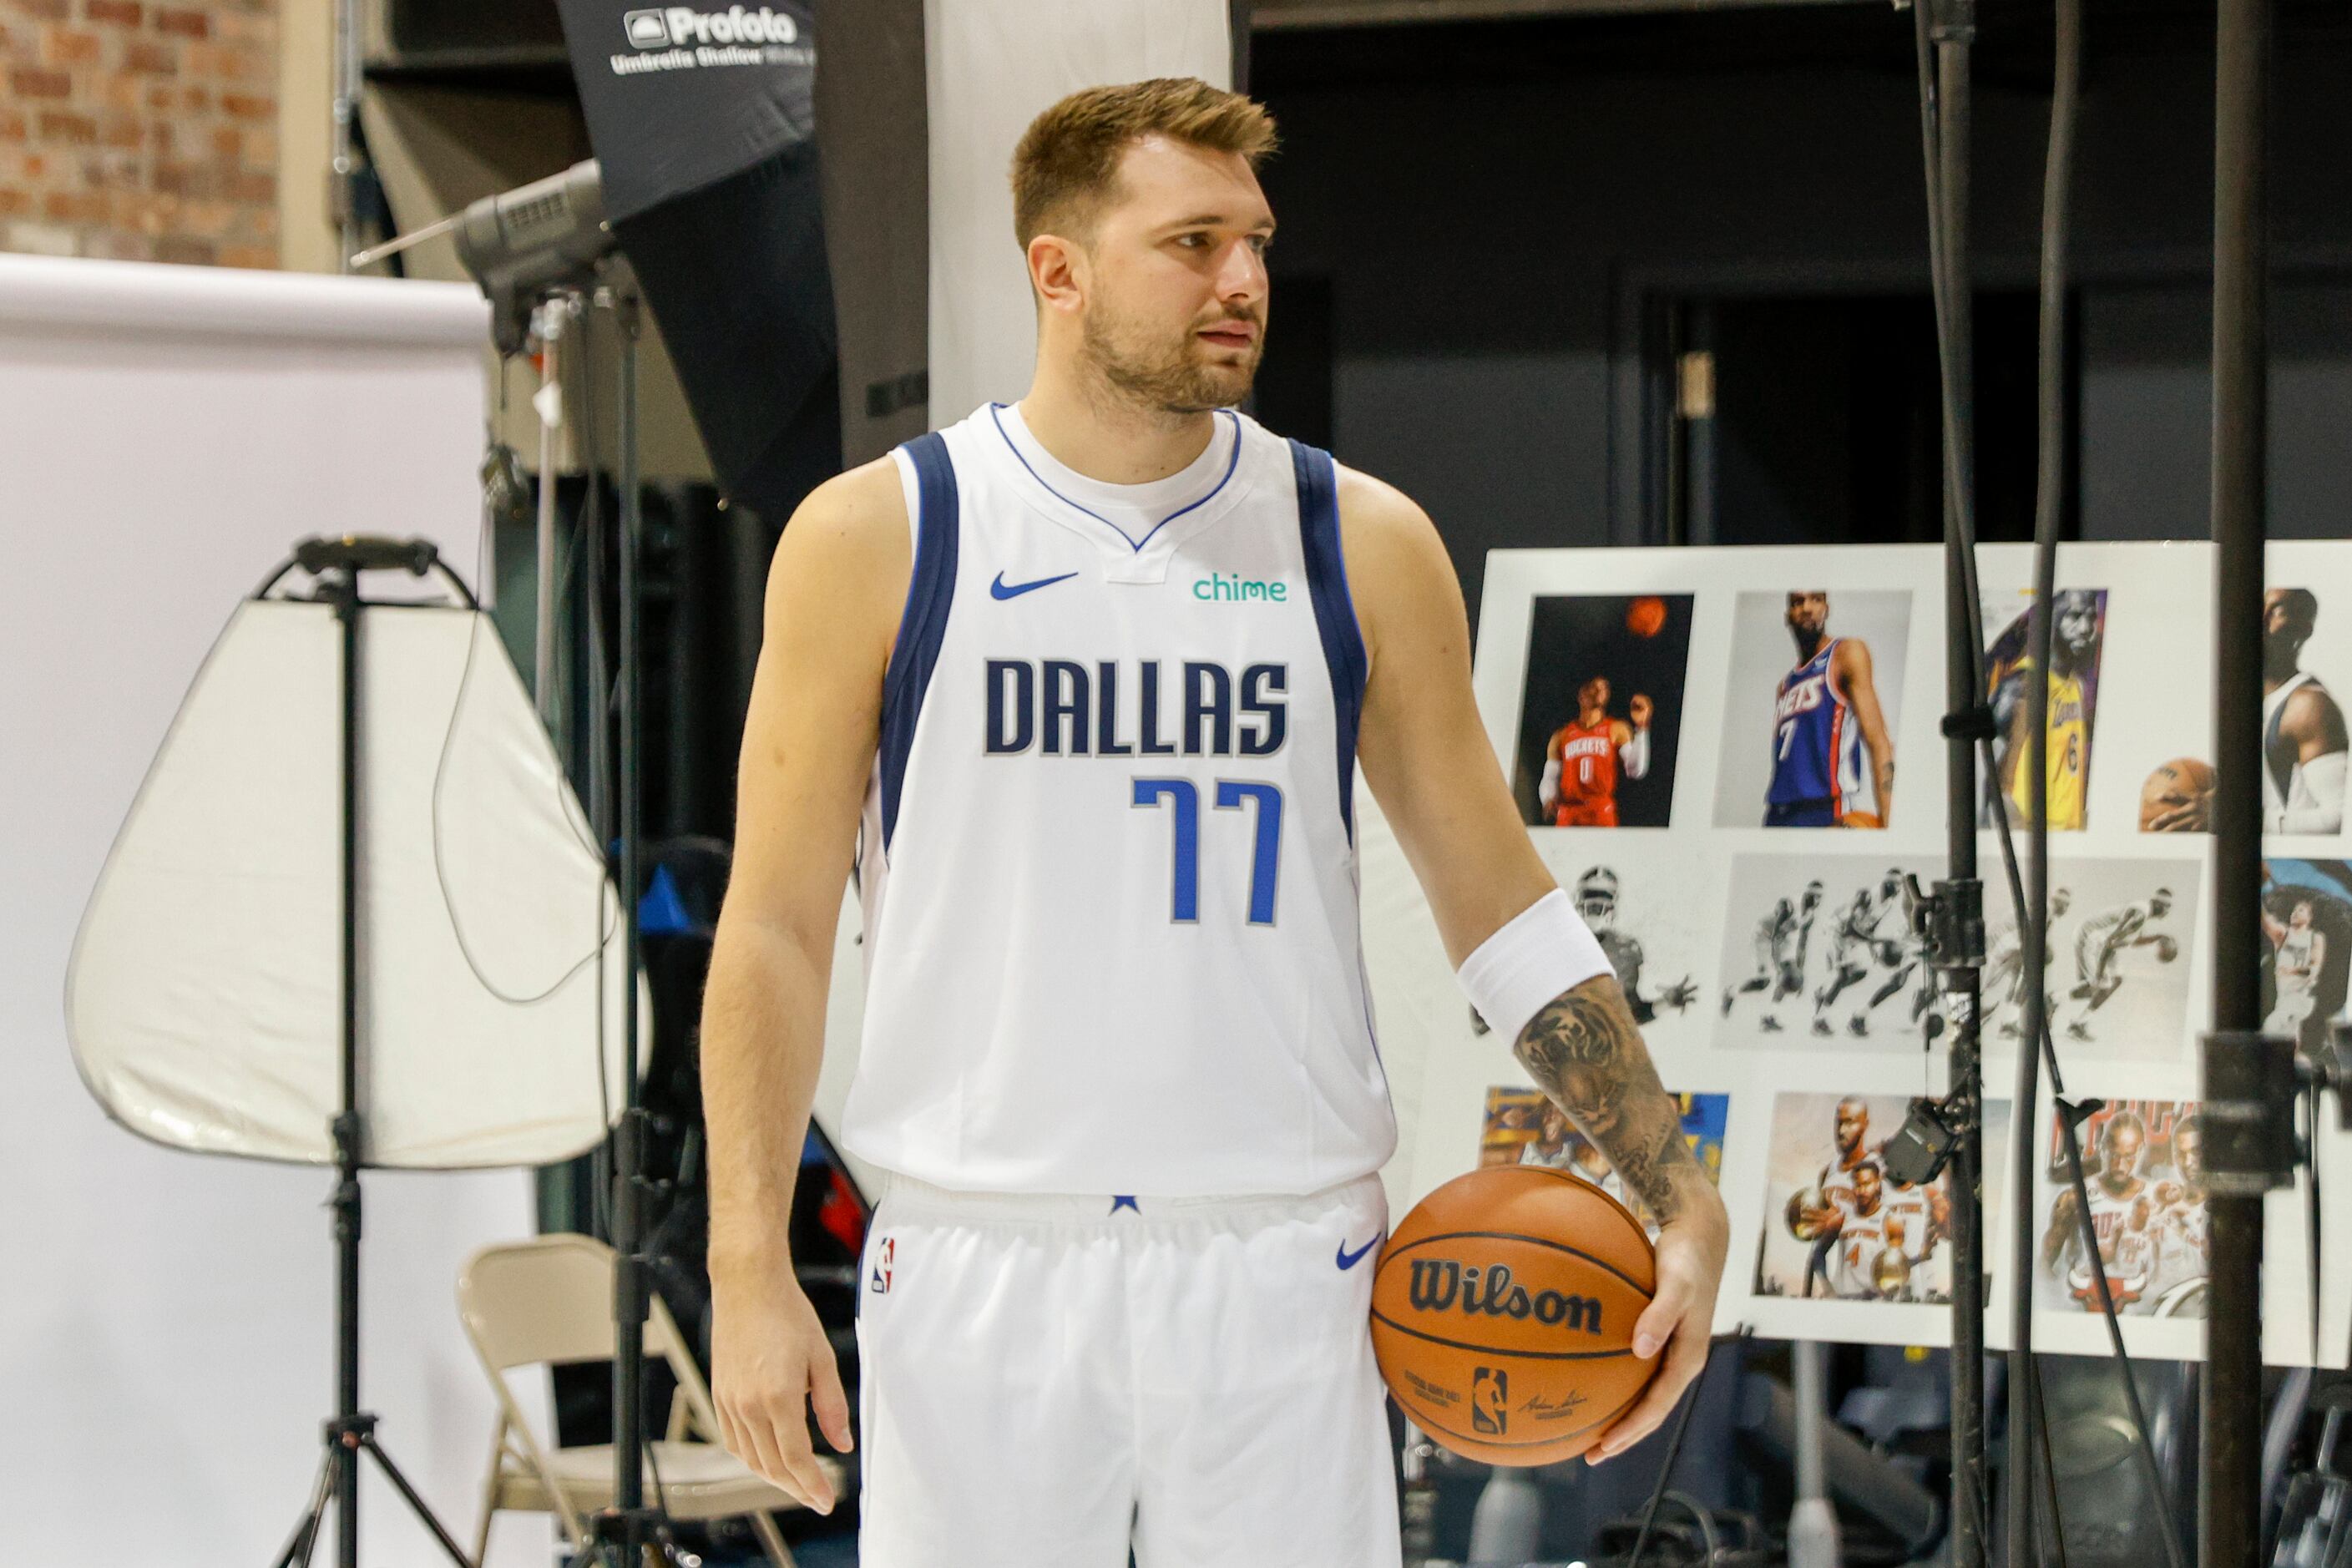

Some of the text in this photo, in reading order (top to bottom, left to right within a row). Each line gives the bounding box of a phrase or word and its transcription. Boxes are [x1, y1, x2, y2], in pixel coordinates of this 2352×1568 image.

[665, 4, 797, 44] Profoto
[609, 48, 696, 75] Umbrella
[1193, 573, 1287, 603] chime
[983, 656, 1289, 758] DALLAS
[1778, 718, 1798, 761] 7
[2066, 732, 2078, 774] 6
[1580, 756, 1593, 784] 0
[1130, 776, 1286, 927] 77
[1409, 1258, 1602, 1336] Wilson
